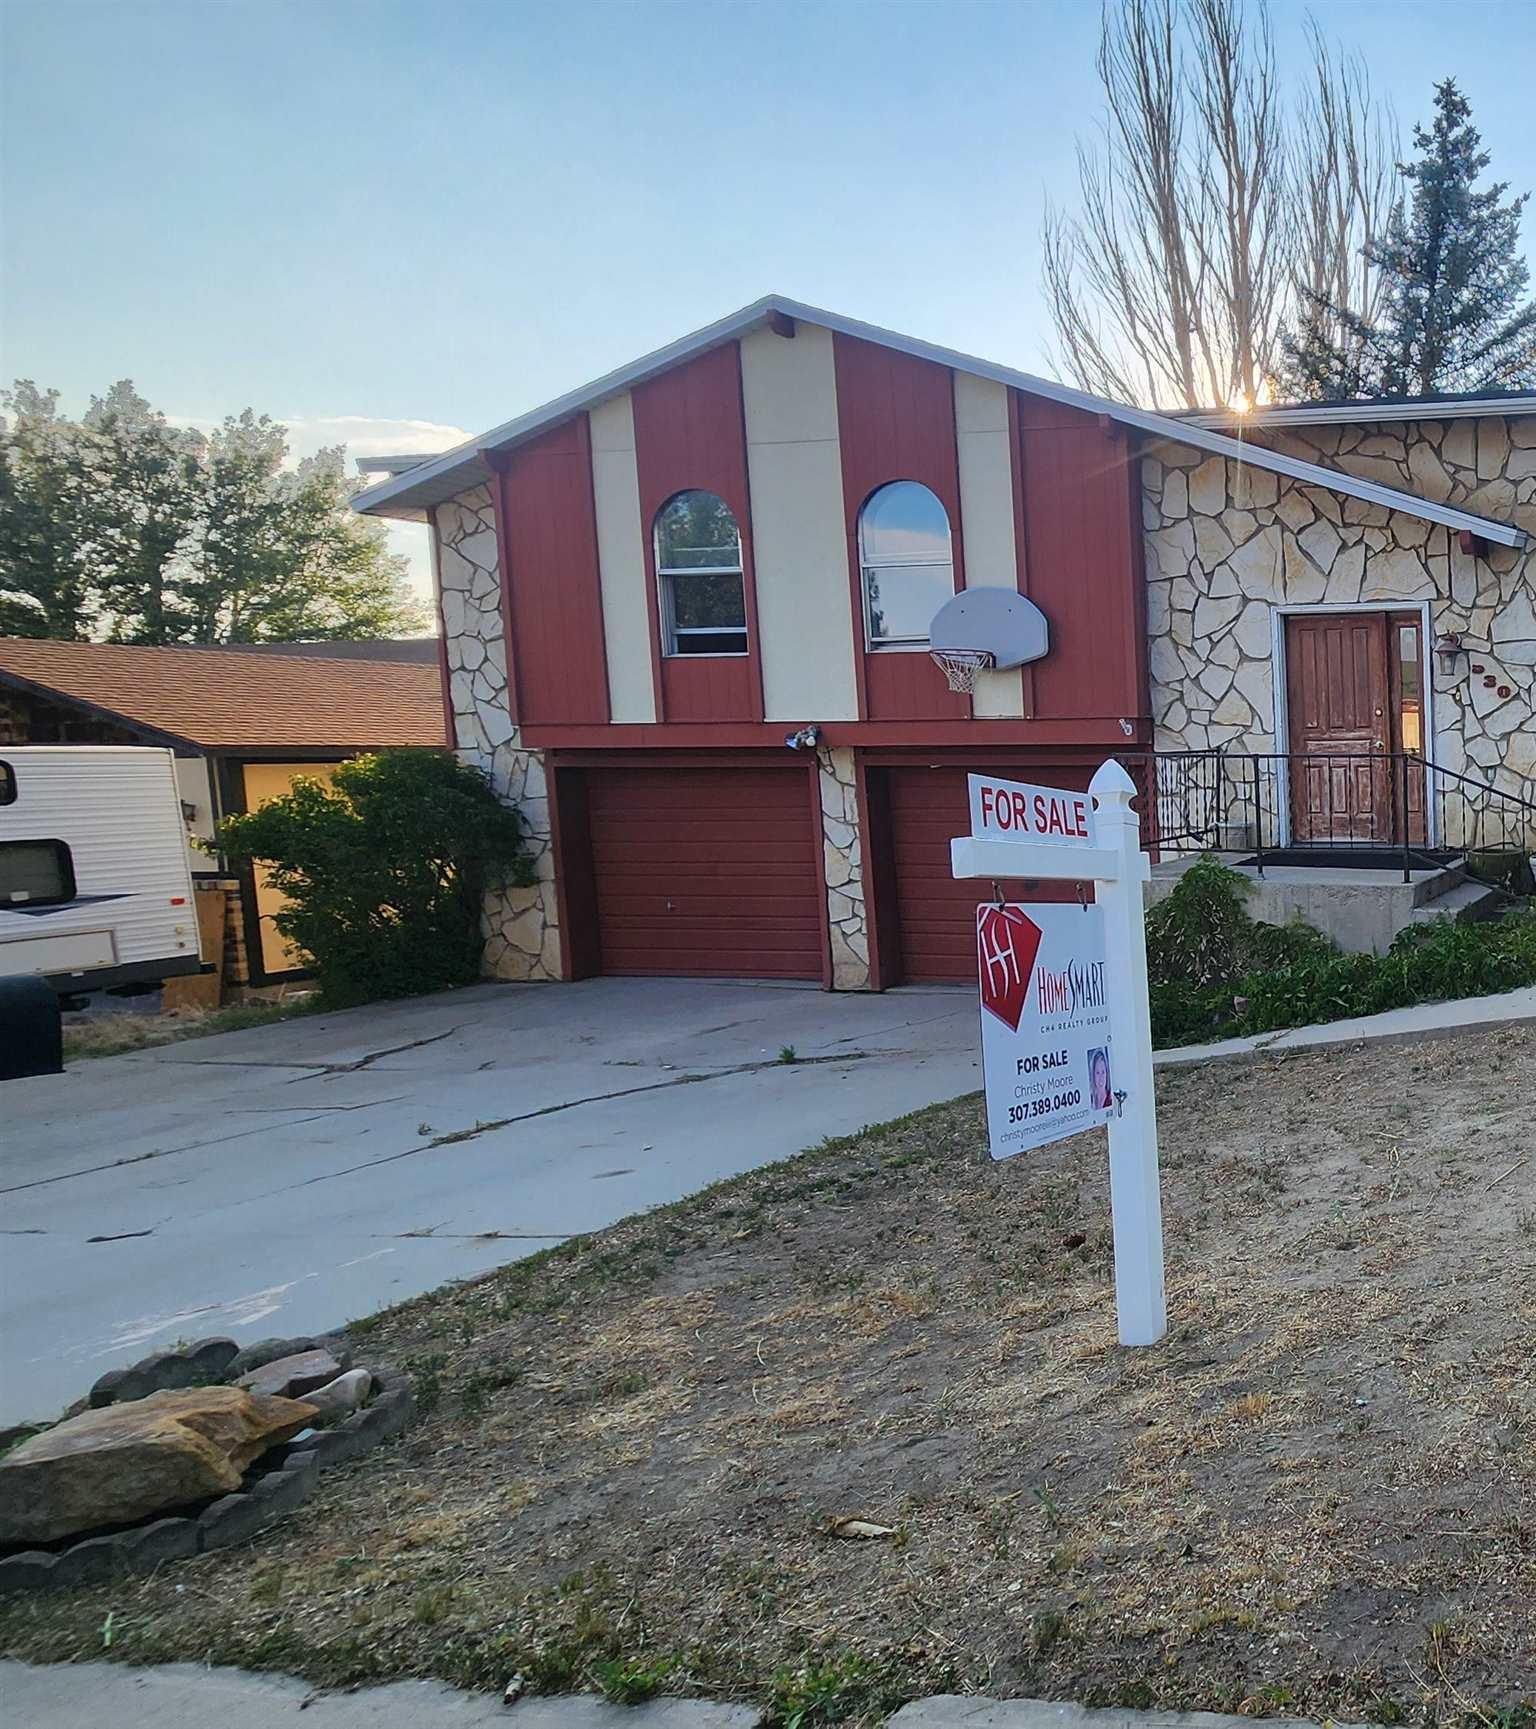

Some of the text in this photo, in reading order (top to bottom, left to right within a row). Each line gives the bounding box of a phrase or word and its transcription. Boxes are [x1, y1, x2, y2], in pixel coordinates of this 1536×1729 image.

[980, 787, 1088, 837] FOR SALE
[1058, 1019, 1083, 1030] REALTY
[1087, 1015, 1108, 1026] GROUP
[1016, 1049, 1069, 1075] FOR SALE
[1014, 1074, 1073, 1098] Christy Moore
[1008, 1089, 1081, 1123] 307.389.0400
